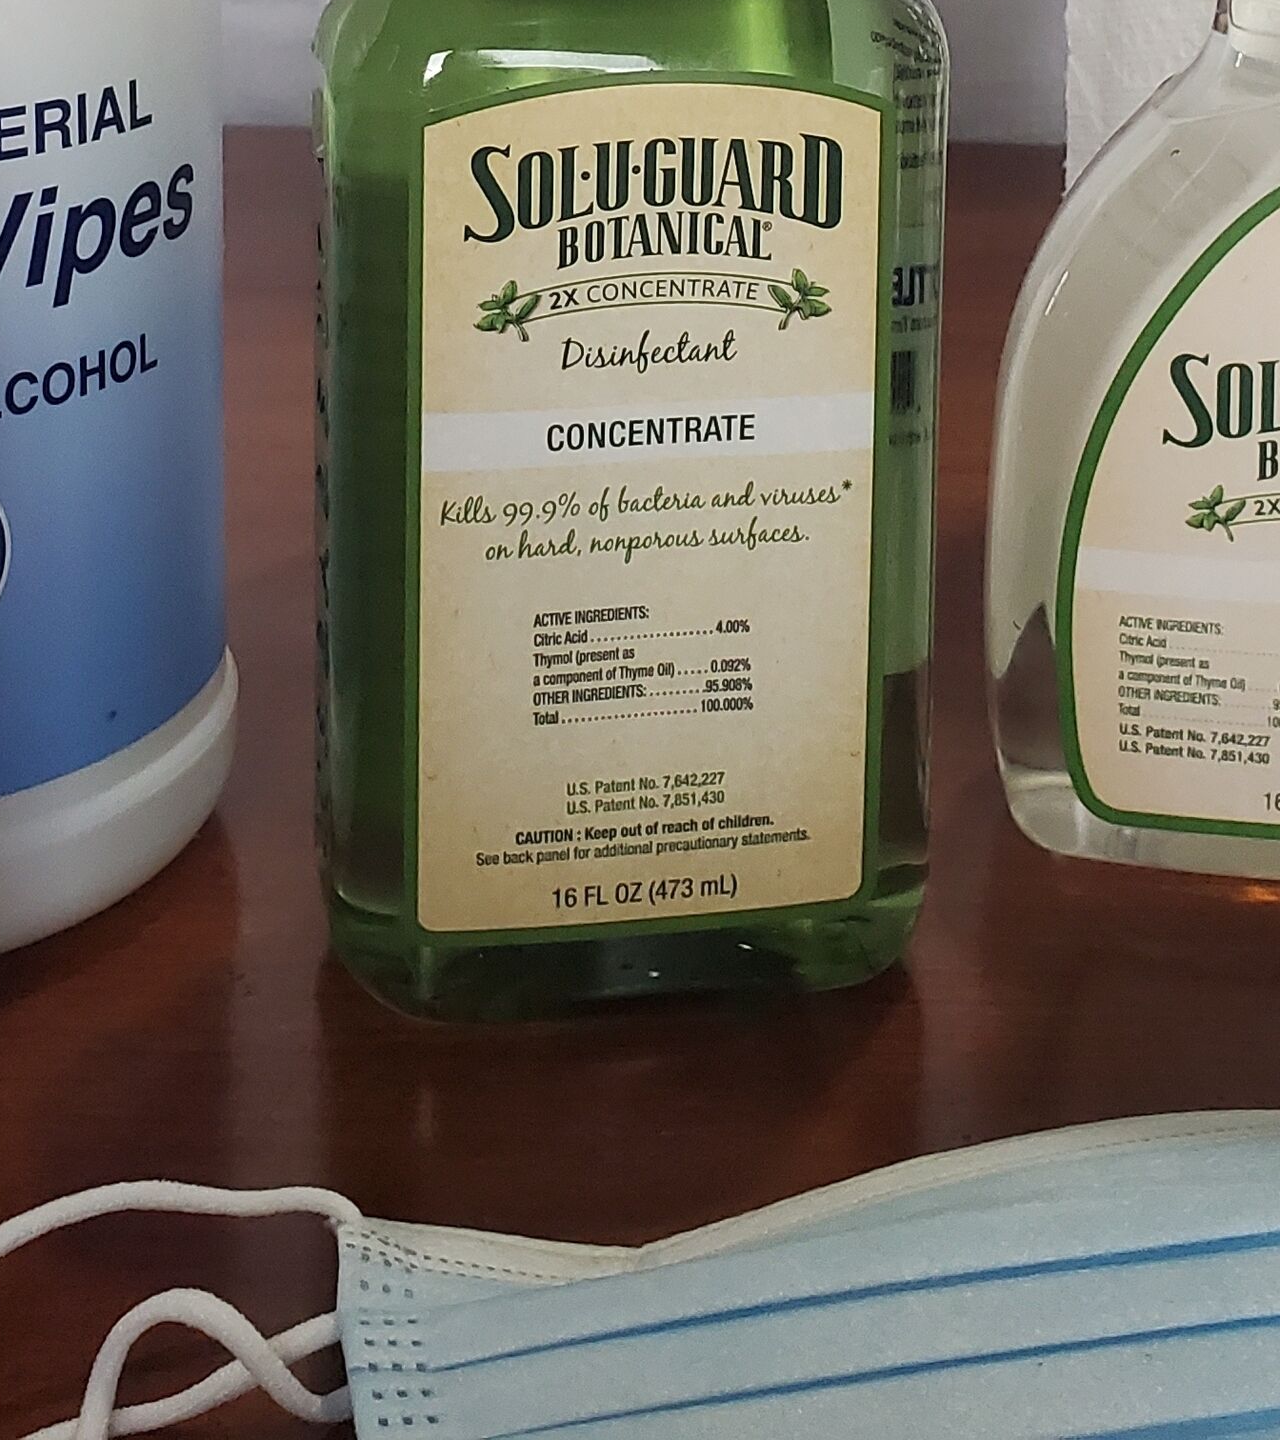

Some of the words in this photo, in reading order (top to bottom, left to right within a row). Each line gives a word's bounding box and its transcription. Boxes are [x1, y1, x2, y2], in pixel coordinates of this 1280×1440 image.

[549, 287, 578, 310] 2X
[587, 278, 759, 303] CONCENTRATE
[561, 330, 737, 373] Disinfectant
[547, 414, 756, 451] CONCENTRATE
[440, 496, 496, 526] Kills
[502, 491, 580, 527] 99.9%
[589, 487, 610, 521] of
[618, 486, 706, 514] bacteria
[711, 481, 754, 508] and
[485, 544, 513, 560] on
[518, 530, 582, 559] hard,
[589, 528, 703, 564] nonporous
[708, 516, 810, 549] surfaces.
[533, 611, 572, 628] ACTIVE
[575, 605, 649, 625] INGREDIENTS:
[1119, 615, 1153, 630] ACTIVE
[534, 632, 562, 647] Citric
[564, 629, 588, 645] Acid
[716, 619, 750, 633] 4.00%
[1119, 633, 1144, 647] Citric
[1146, 635, 1167, 648] Acid
[533, 651, 573, 668] Thymol
[575, 647, 620, 666] (present
[622, 648, 635, 659] as
[533, 676, 540, 686] a
[543, 668, 603, 687] component
[606, 666, 617, 679] of
[620, 663, 654, 681] Thyme
[657, 662, 675, 678] Oil)
[710, 658, 751, 672] 0.092%
[533, 690, 569, 706] OTHER
[572, 684, 647, 703] INGREDIENTS:
[1118, 685, 1151, 700] OTHER
[533, 711, 559, 726] Total
[701, 696, 753, 713] 100.000%
[1119, 723, 1141, 737] U.S.
[1145, 726, 1184, 741] Patent
[1187, 729, 1206, 742] No.
[1210, 731, 1271, 747] 7,642,227
[566, 782, 591, 796] U.S.
[595, 778, 636, 794] Patent
[638, 776, 660, 790] No.
[662, 771, 725, 789] 7,642,227
[566, 800, 591, 815] U.S.
[595, 797, 636, 813] Patent
[638, 795, 660, 809] No.
[662, 791, 725, 808] 7,851,430
[585, 823, 618, 842] Keep
[620, 823, 642, 838] out
[644, 821, 659, 836] of
[661, 818, 699, 834] reach
[702, 817, 716, 831] of
[717, 813, 775, 830] children.
[476, 852, 500, 867] See
[503, 846, 534, 865] back
[536, 847, 571, 865] panel
[573, 843, 591, 860] for
[593, 841, 653, 858] additional
[656, 835, 739, 857] precautionary
[741, 828, 812, 847] statements.
[551, 887, 578, 909] 16
[584, 885, 609, 907] FL
[615, 882, 643, 905] OZ
[648, 877, 693, 907] (473
[700, 873, 738, 898] mL)
